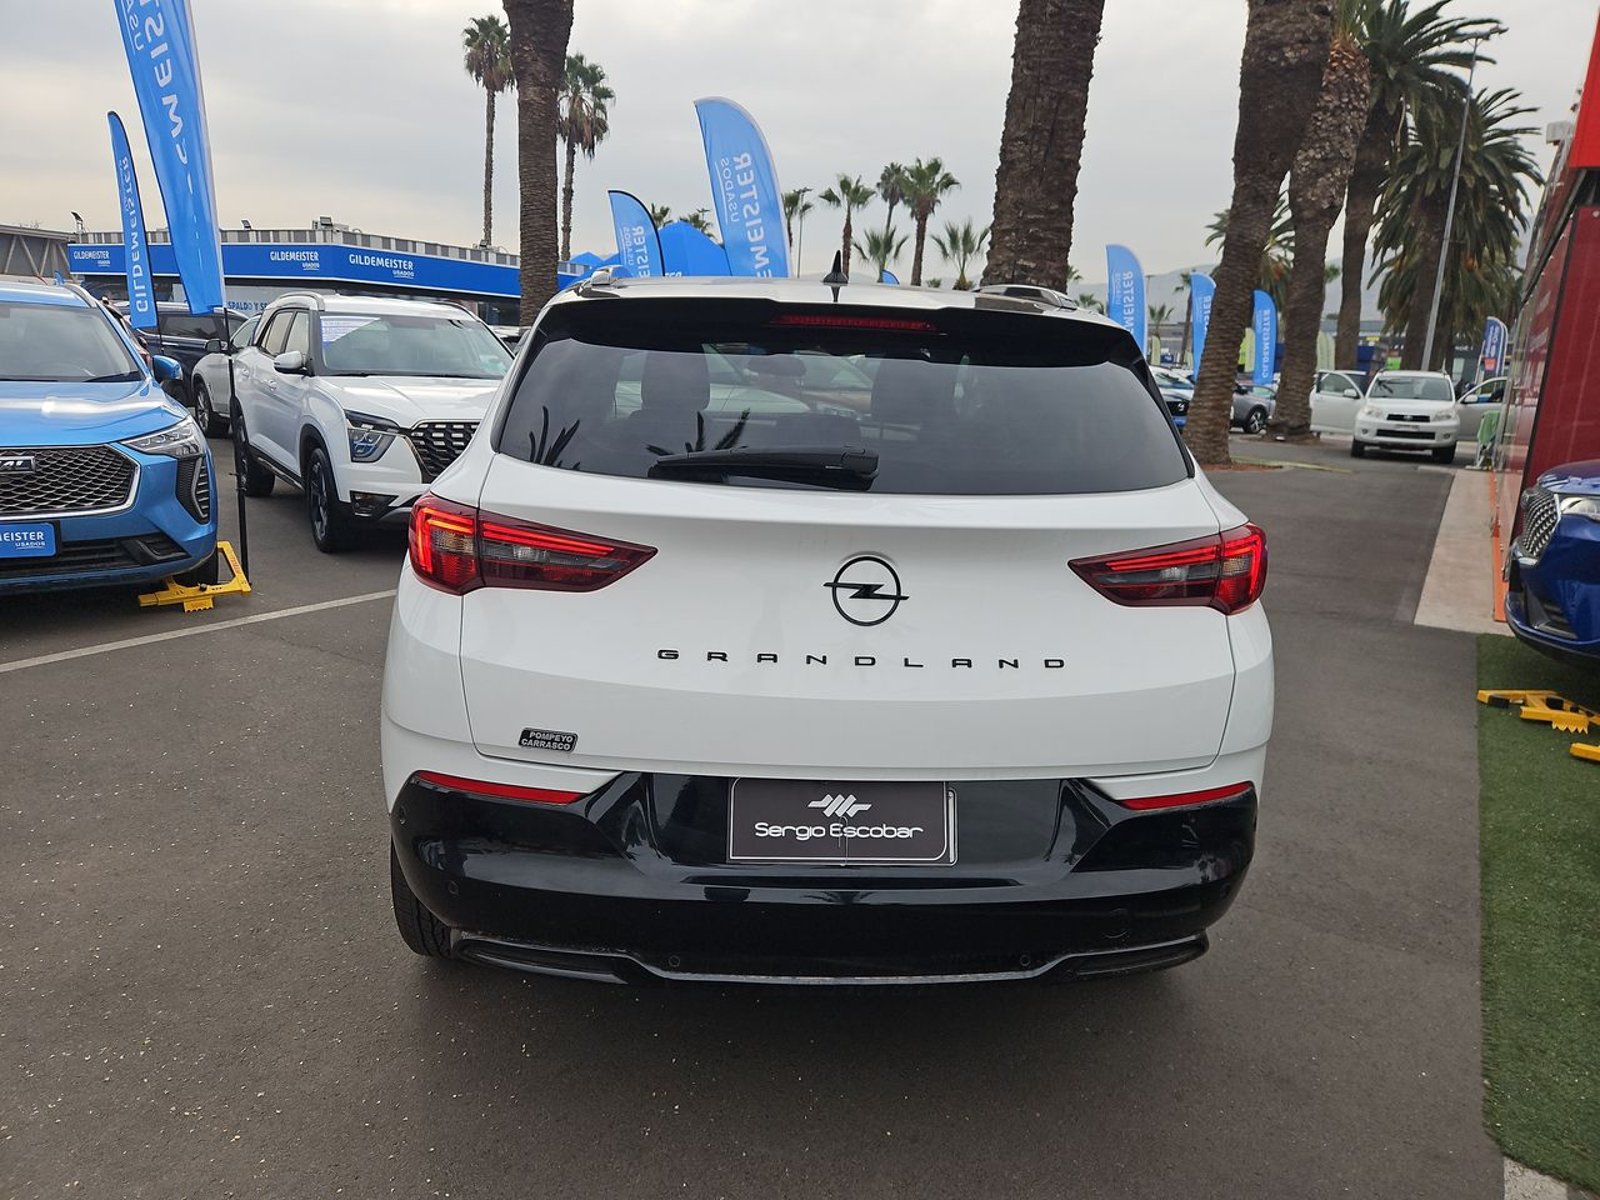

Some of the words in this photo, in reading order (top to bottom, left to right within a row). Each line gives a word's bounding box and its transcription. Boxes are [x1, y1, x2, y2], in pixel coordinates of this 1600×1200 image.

[73, 250, 110, 260] GILDEMEISTER
[269, 251, 319, 262] GILDEMEISTER
[349, 253, 414, 271] GILDEMEISTER
[393, 269, 415, 277] USADOS
[0, 531, 45, 541] EISTER
[657, 648, 1065, 669] GRANDLAND
[529, 732, 574, 743] POMPEYO
[521, 738, 571, 751] CARRASCO
[755, 822, 826, 841] Sergio
[829, 823, 924, 839] Escobar
